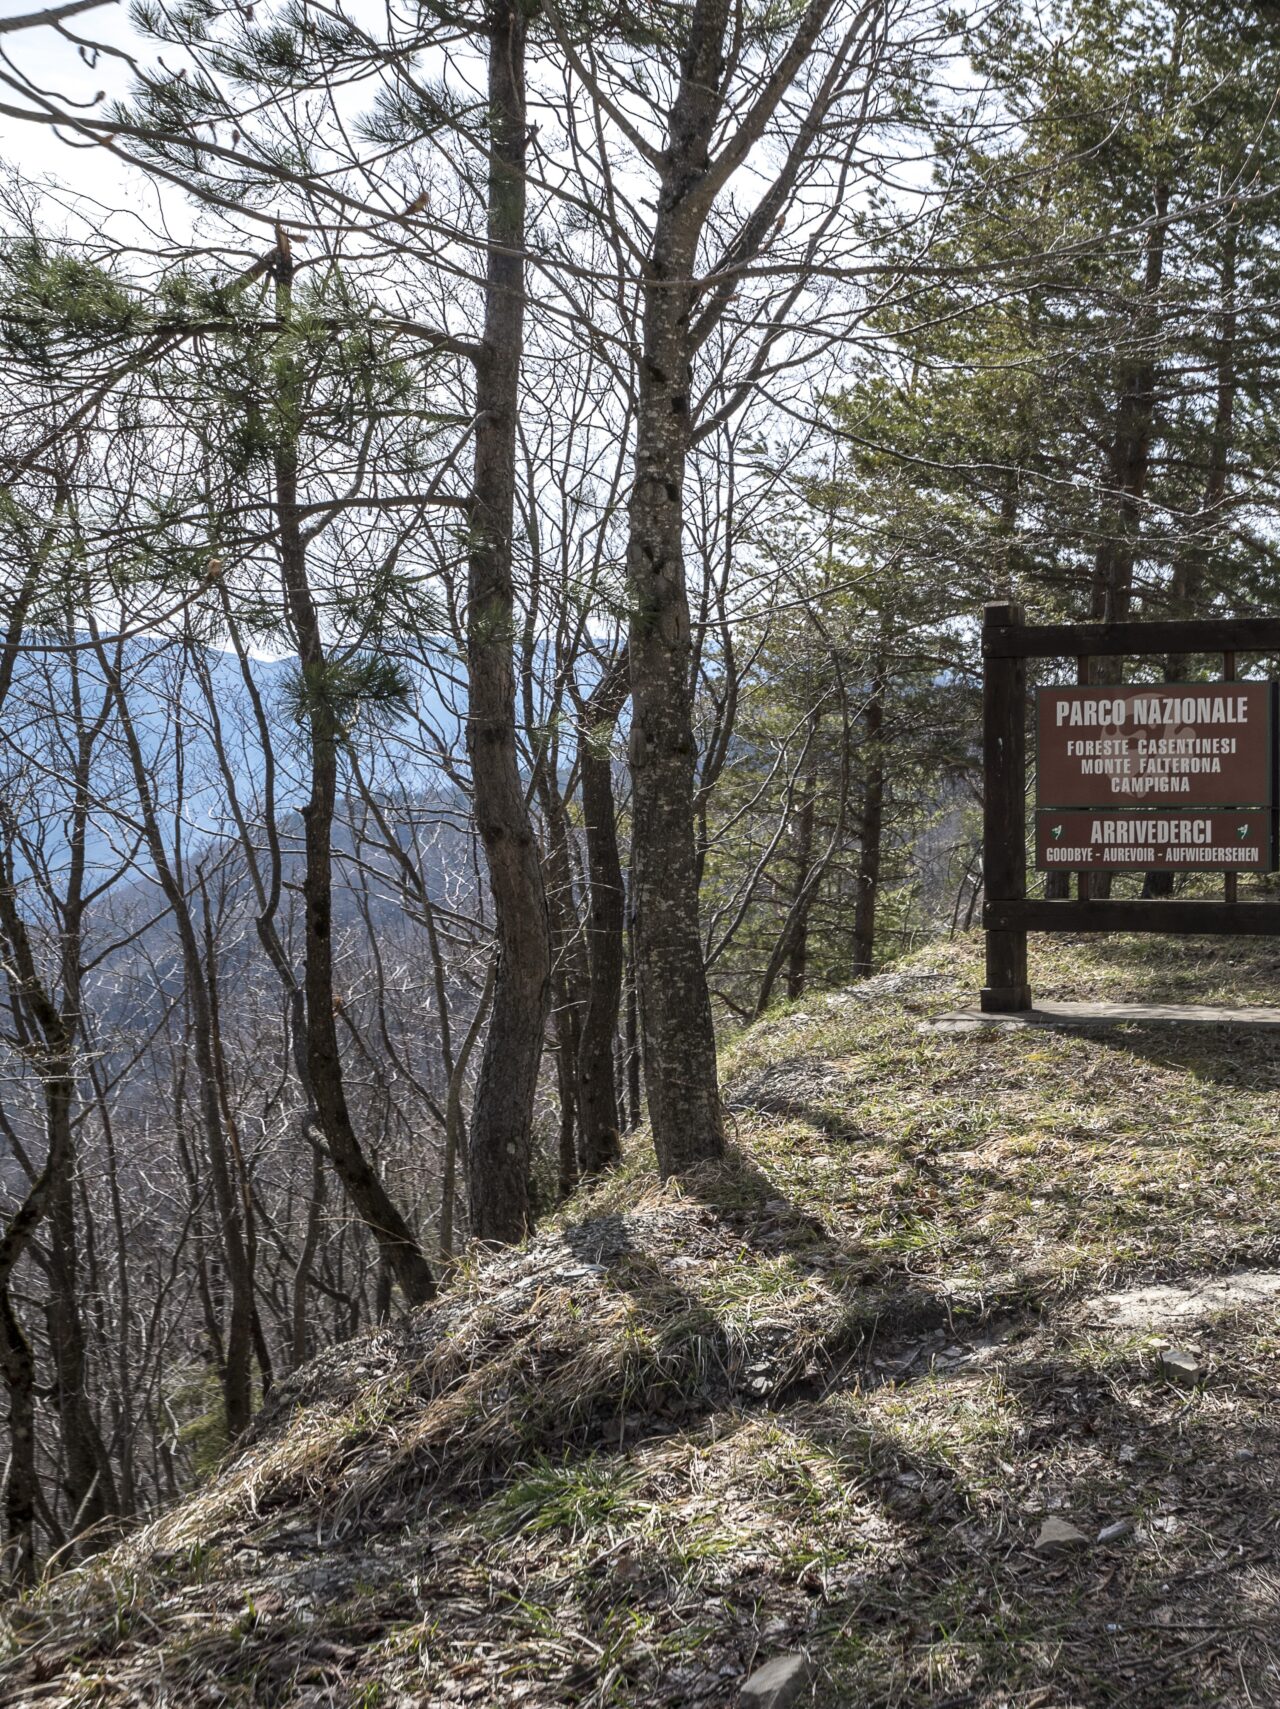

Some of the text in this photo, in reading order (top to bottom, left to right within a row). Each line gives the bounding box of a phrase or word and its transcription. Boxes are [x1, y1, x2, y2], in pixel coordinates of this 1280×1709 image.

[1056, 696, 1248, 726] PARCO NAZIONALE
[1067, 738, 1236, 756] FORESTE CASENTINESI
[1081, 757, 1221, 774] MONTE FALTERONA
[1111, 776, 1190, 793] CAMPIGNA
[1091, 820, 1212, 844] ARRIVEDERCI
[1046, 848, 1093, 862] GOODBYE
[1103, 848, 1155, 862] AUREVOIR
[1165, 847, 1259, 862] AUFWIEDERSEHEN
